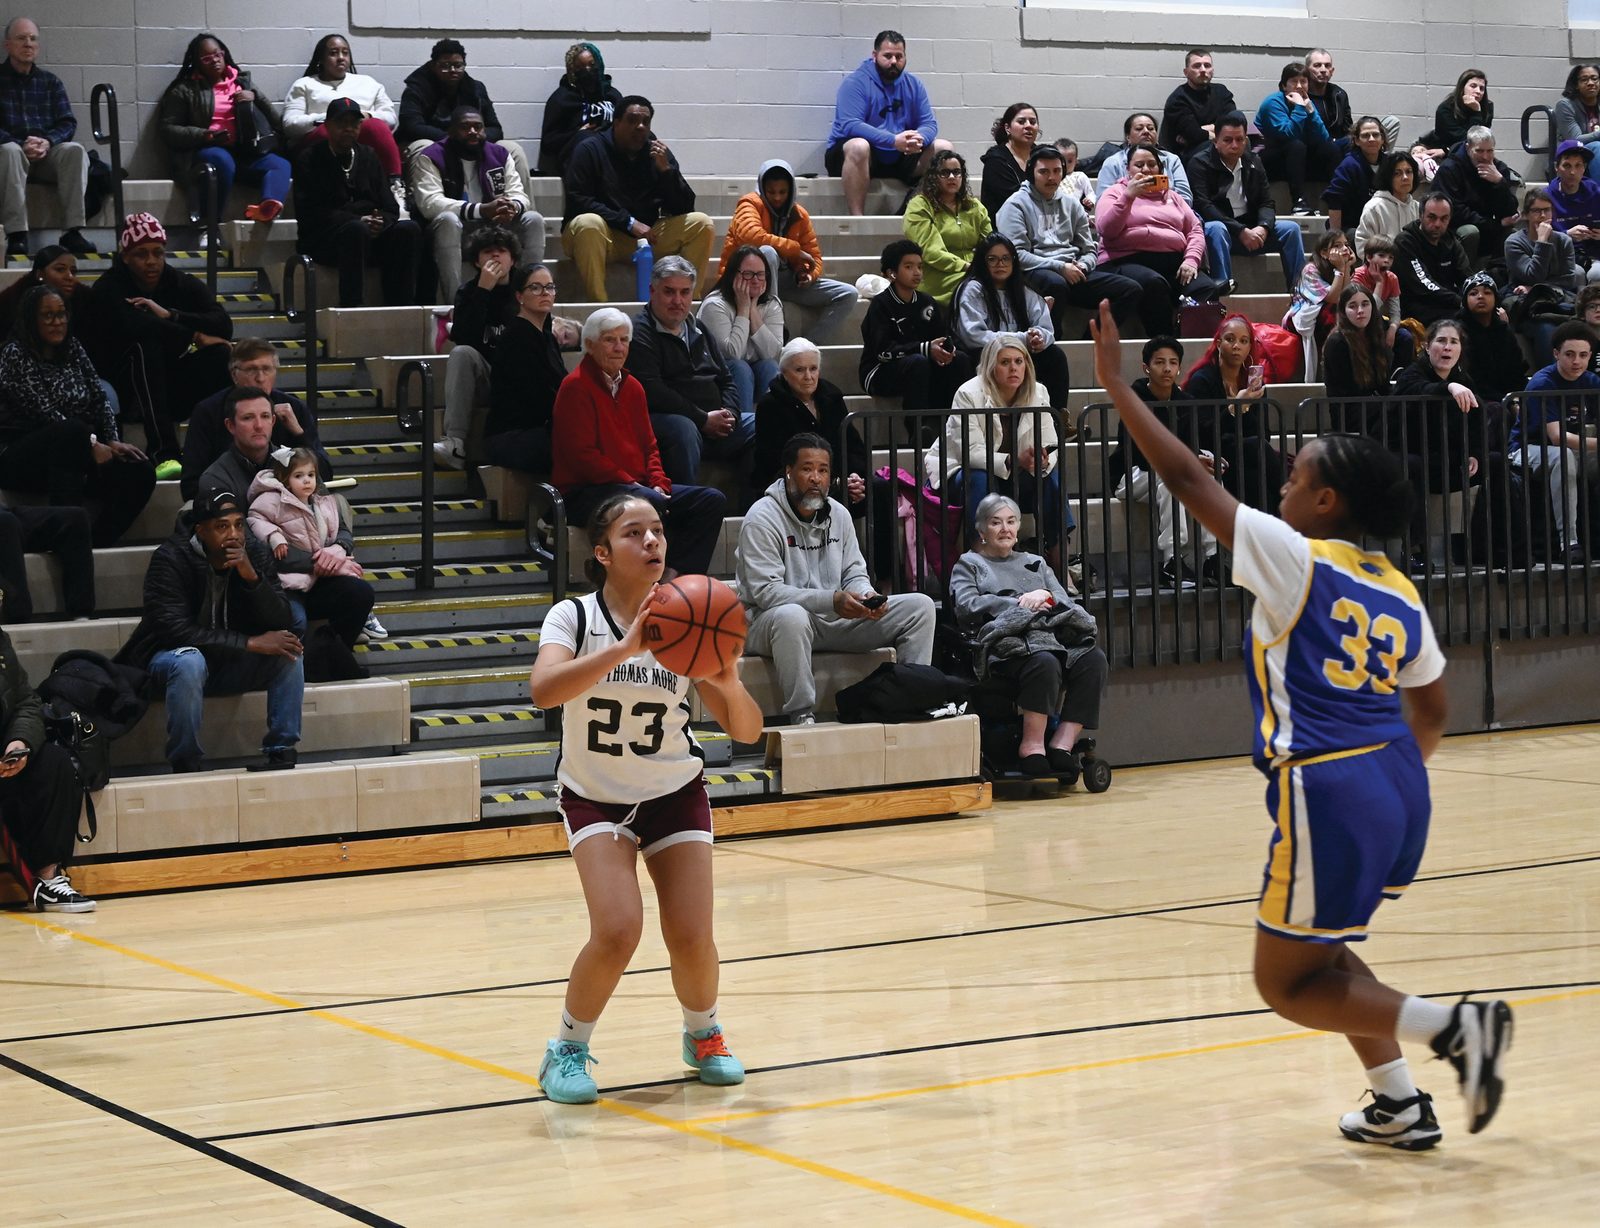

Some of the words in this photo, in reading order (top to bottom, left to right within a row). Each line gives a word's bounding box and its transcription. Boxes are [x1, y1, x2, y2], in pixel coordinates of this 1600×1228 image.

[1322, 596, 1408, 695] 33
[652, 668, 678, 695] MORE
[587, 697, 668, 756] 23
